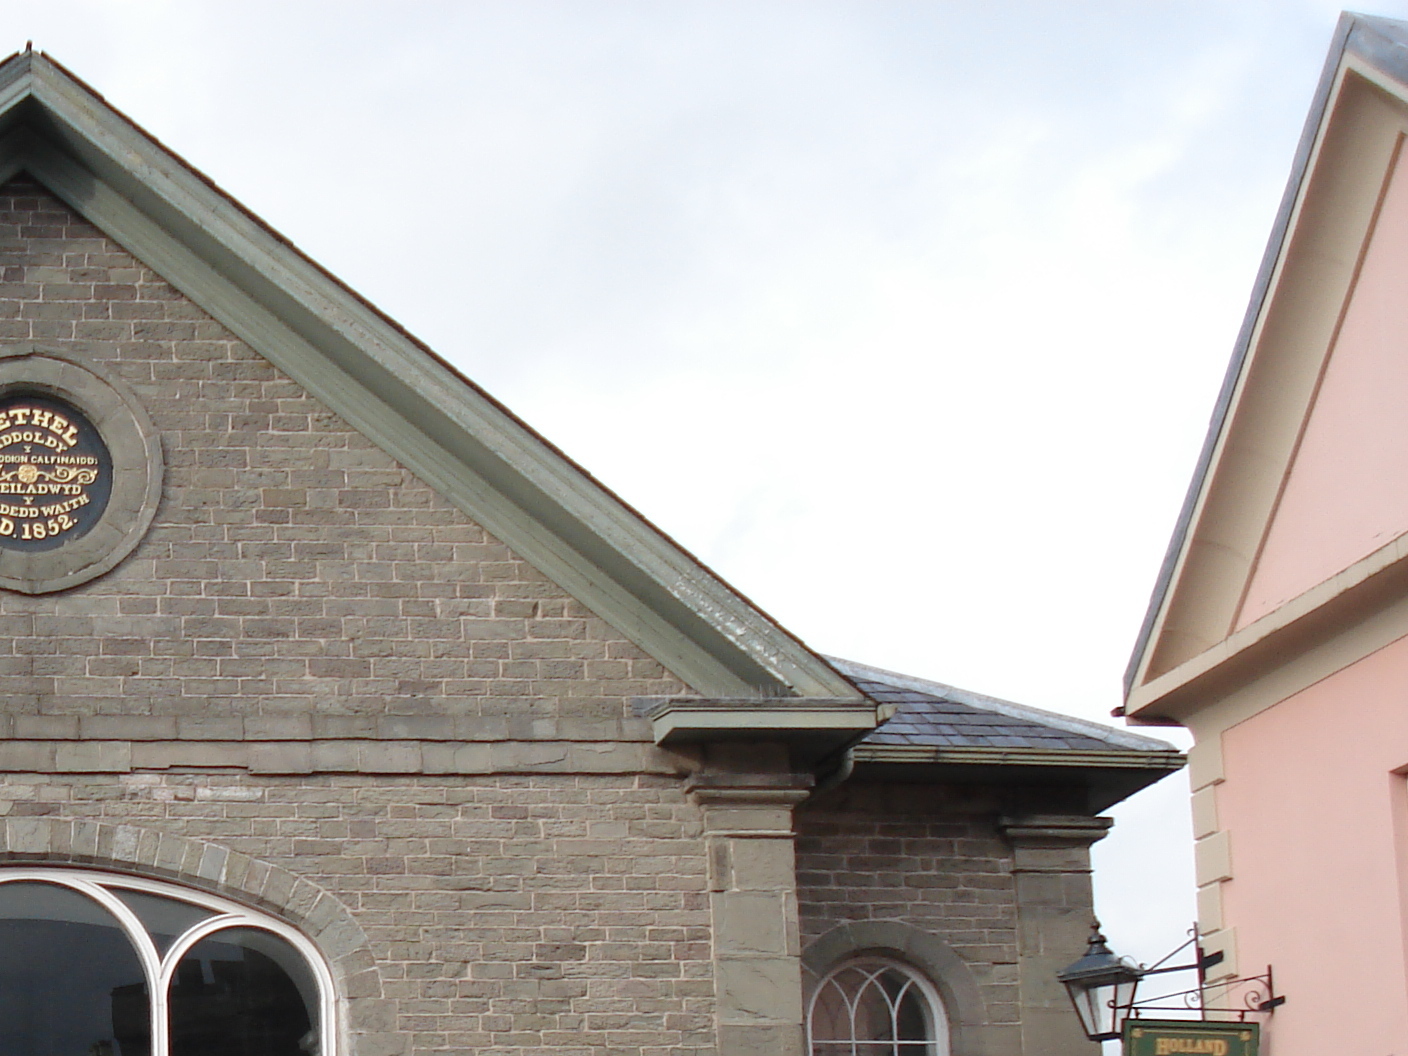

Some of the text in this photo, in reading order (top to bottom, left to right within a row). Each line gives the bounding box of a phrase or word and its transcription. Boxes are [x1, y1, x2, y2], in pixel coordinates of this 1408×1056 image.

[23, 445, 32, 453] Y
[22, 496, 34, 505] Y
[40, 494, 90, 517] WAITH
[1154, 1037, 1229, 1056] HOLLAND
